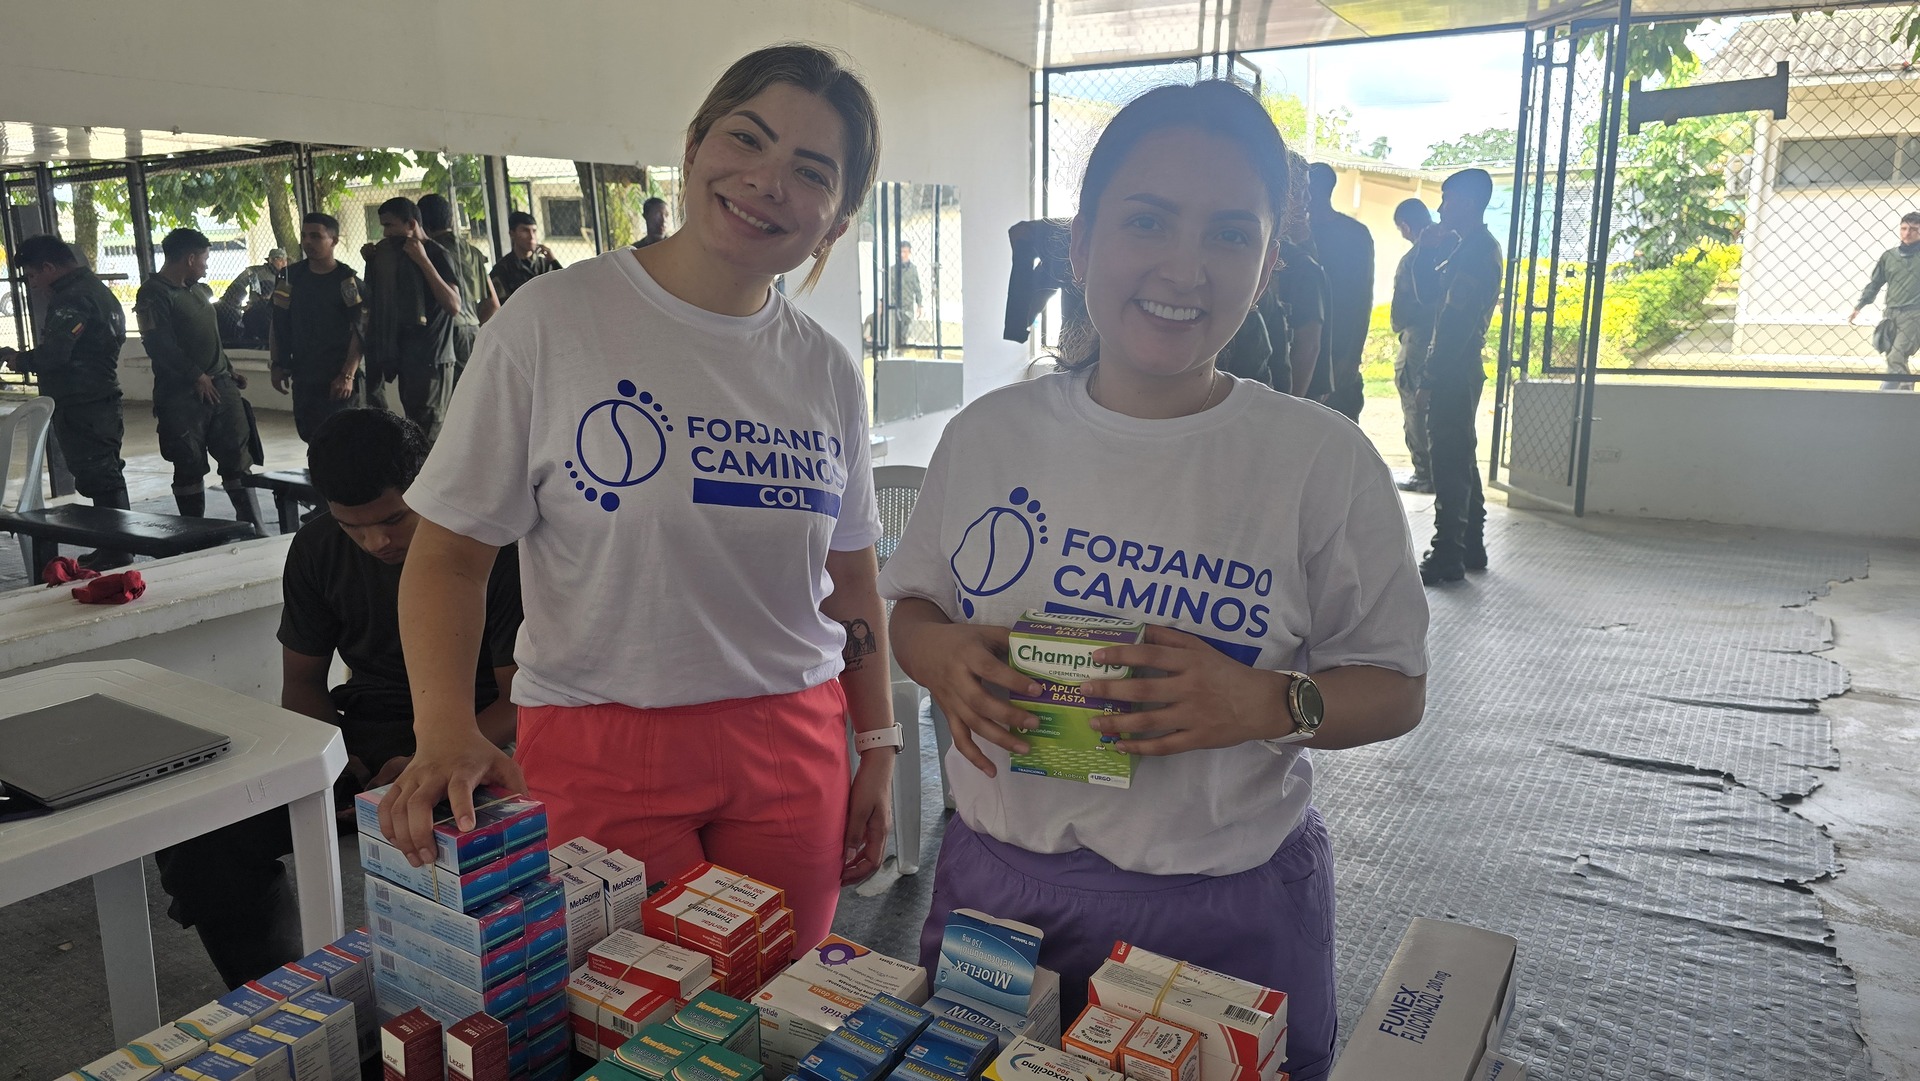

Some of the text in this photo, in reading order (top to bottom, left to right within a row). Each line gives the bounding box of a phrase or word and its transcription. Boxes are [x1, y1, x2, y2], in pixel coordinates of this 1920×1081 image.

[687, 416, 841, 459] FORJANDO
[691, 446, 846, 490] CAMINOS
[759, 487, 811, 509] COL
[1061, 527, 1273, 597] FORJANDO
[1053, 564, 1270, 639] CAMINOS
[1055, 630, 1090, 638] BASTA
[1048, 669, 1090, 679] CIPERMETRINA
[1049, 684, 1081, 695] APLIC
[1052, 693, 1086, 704] BASTA
[612, 871, 643, 893] MetaSpray
[715, 879, 759, 900] Trimebuina
[569, 888, 601, 910] MetaSpray
[961, 933, 983, 949] 750 mg
[960, 946, 1015, 972] Metocarbamol
[581, 972, 625, 996] Trimebuina
[955, 959, 1014, 990] MIOFLEX
[812, 986, 831, 998] dosis
[877, 996, 923, 1018] Metroxazide
[1379, 983, 1419, 1036] FUNEX
[1400, 970, 1452, 1044] FLUCONAZOL 200 mg
[945, 1006, 1006, 1032] MIOFLEX
[838, 1028, 885, 1056] Metroxazide
[938, 1020, 988, 1042] Metroxazide
[1044, 1061, 1071, 1076] 500 mg
